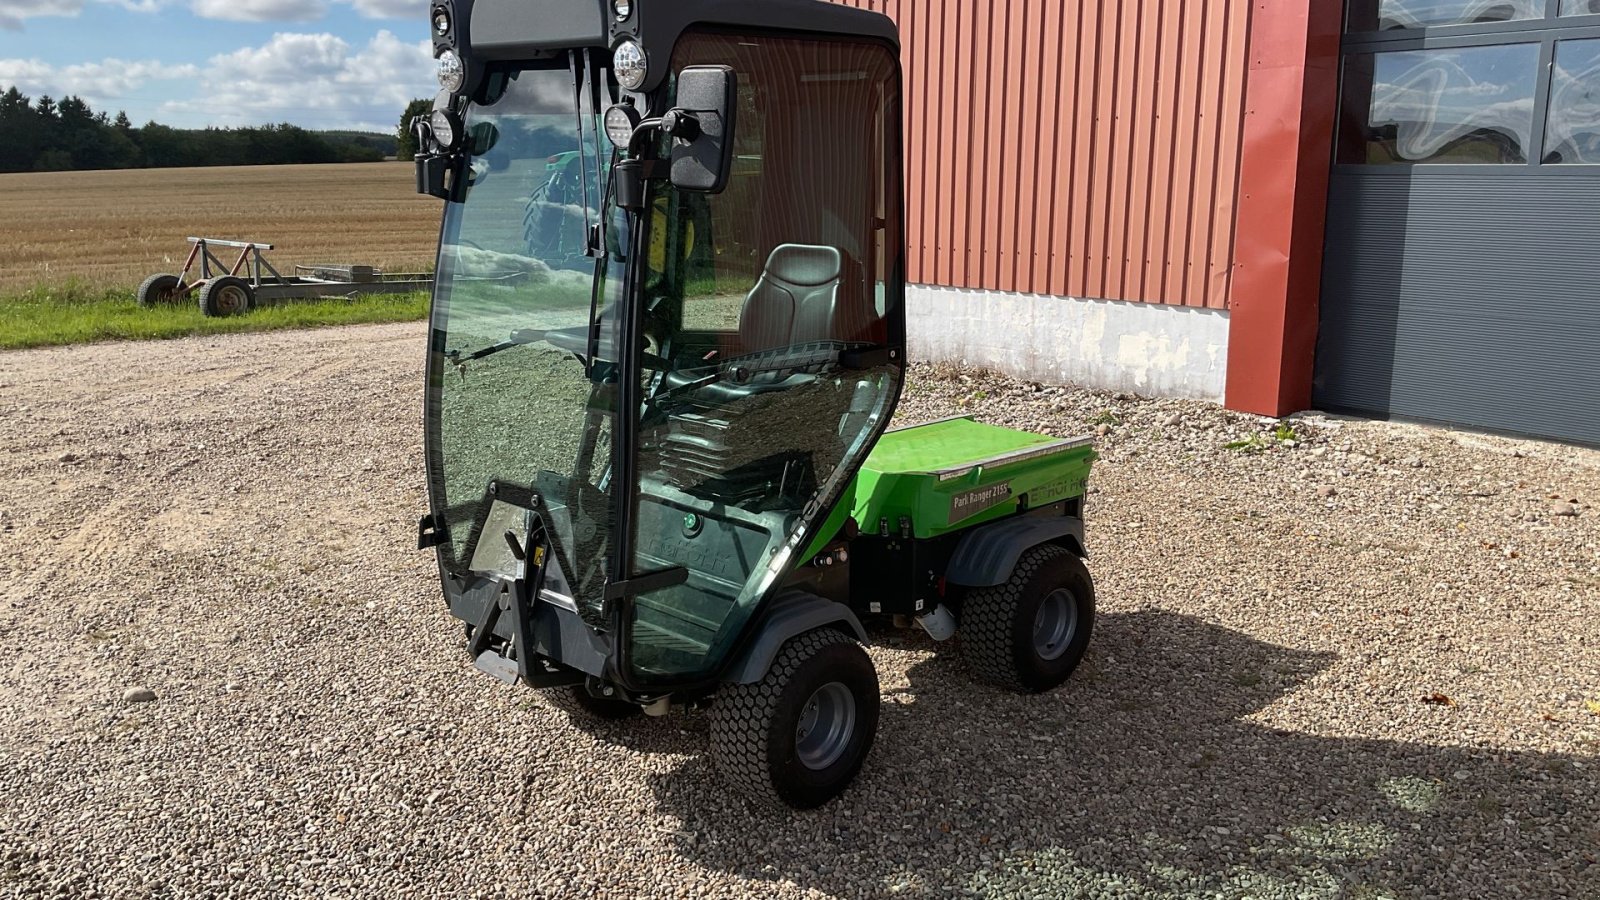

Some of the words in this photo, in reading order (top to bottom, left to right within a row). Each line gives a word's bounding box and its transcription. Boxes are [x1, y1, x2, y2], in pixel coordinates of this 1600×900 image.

[954, 494, 969, 509] Park
[969, 489, 992, 503] Ranger
[992, 483, 1008, 497] 2155
